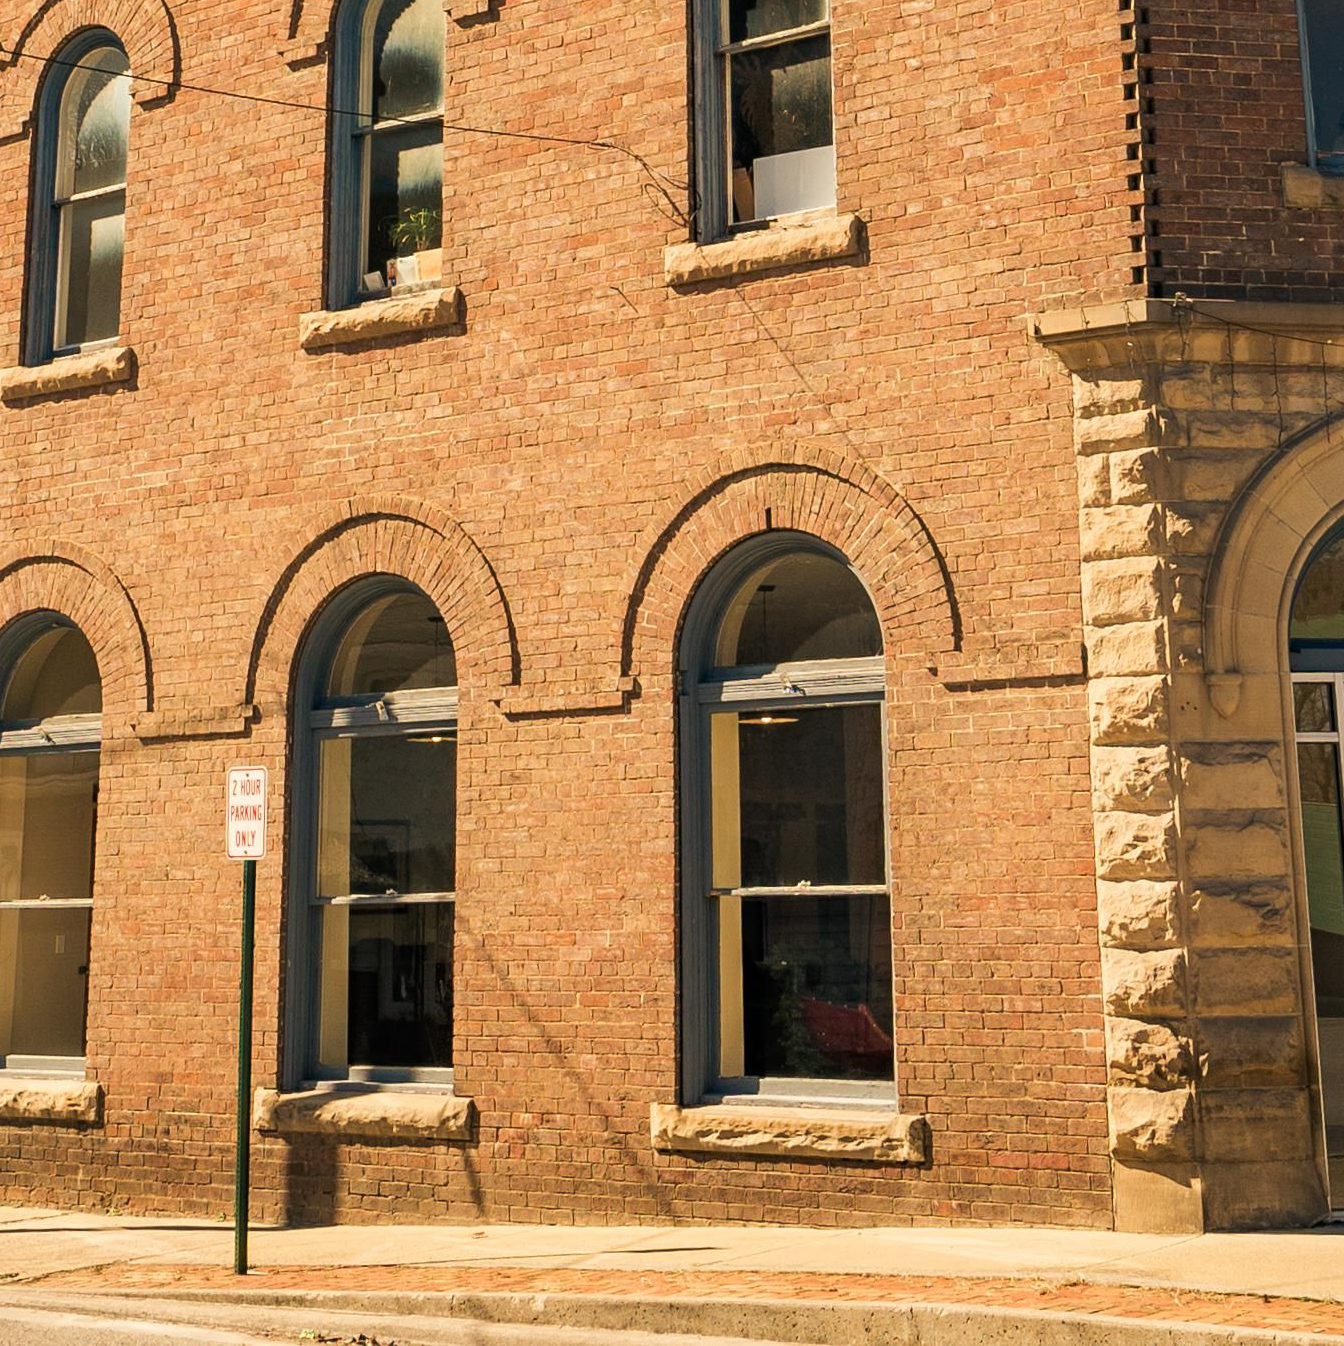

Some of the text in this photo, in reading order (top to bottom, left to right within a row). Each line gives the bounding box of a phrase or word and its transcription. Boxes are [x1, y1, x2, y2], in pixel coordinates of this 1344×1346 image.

[232, 779, 261, 796] 2 HOUR
[230, 805, 262, 822] PARKING
[235, 830, 256, 847] ONLY
